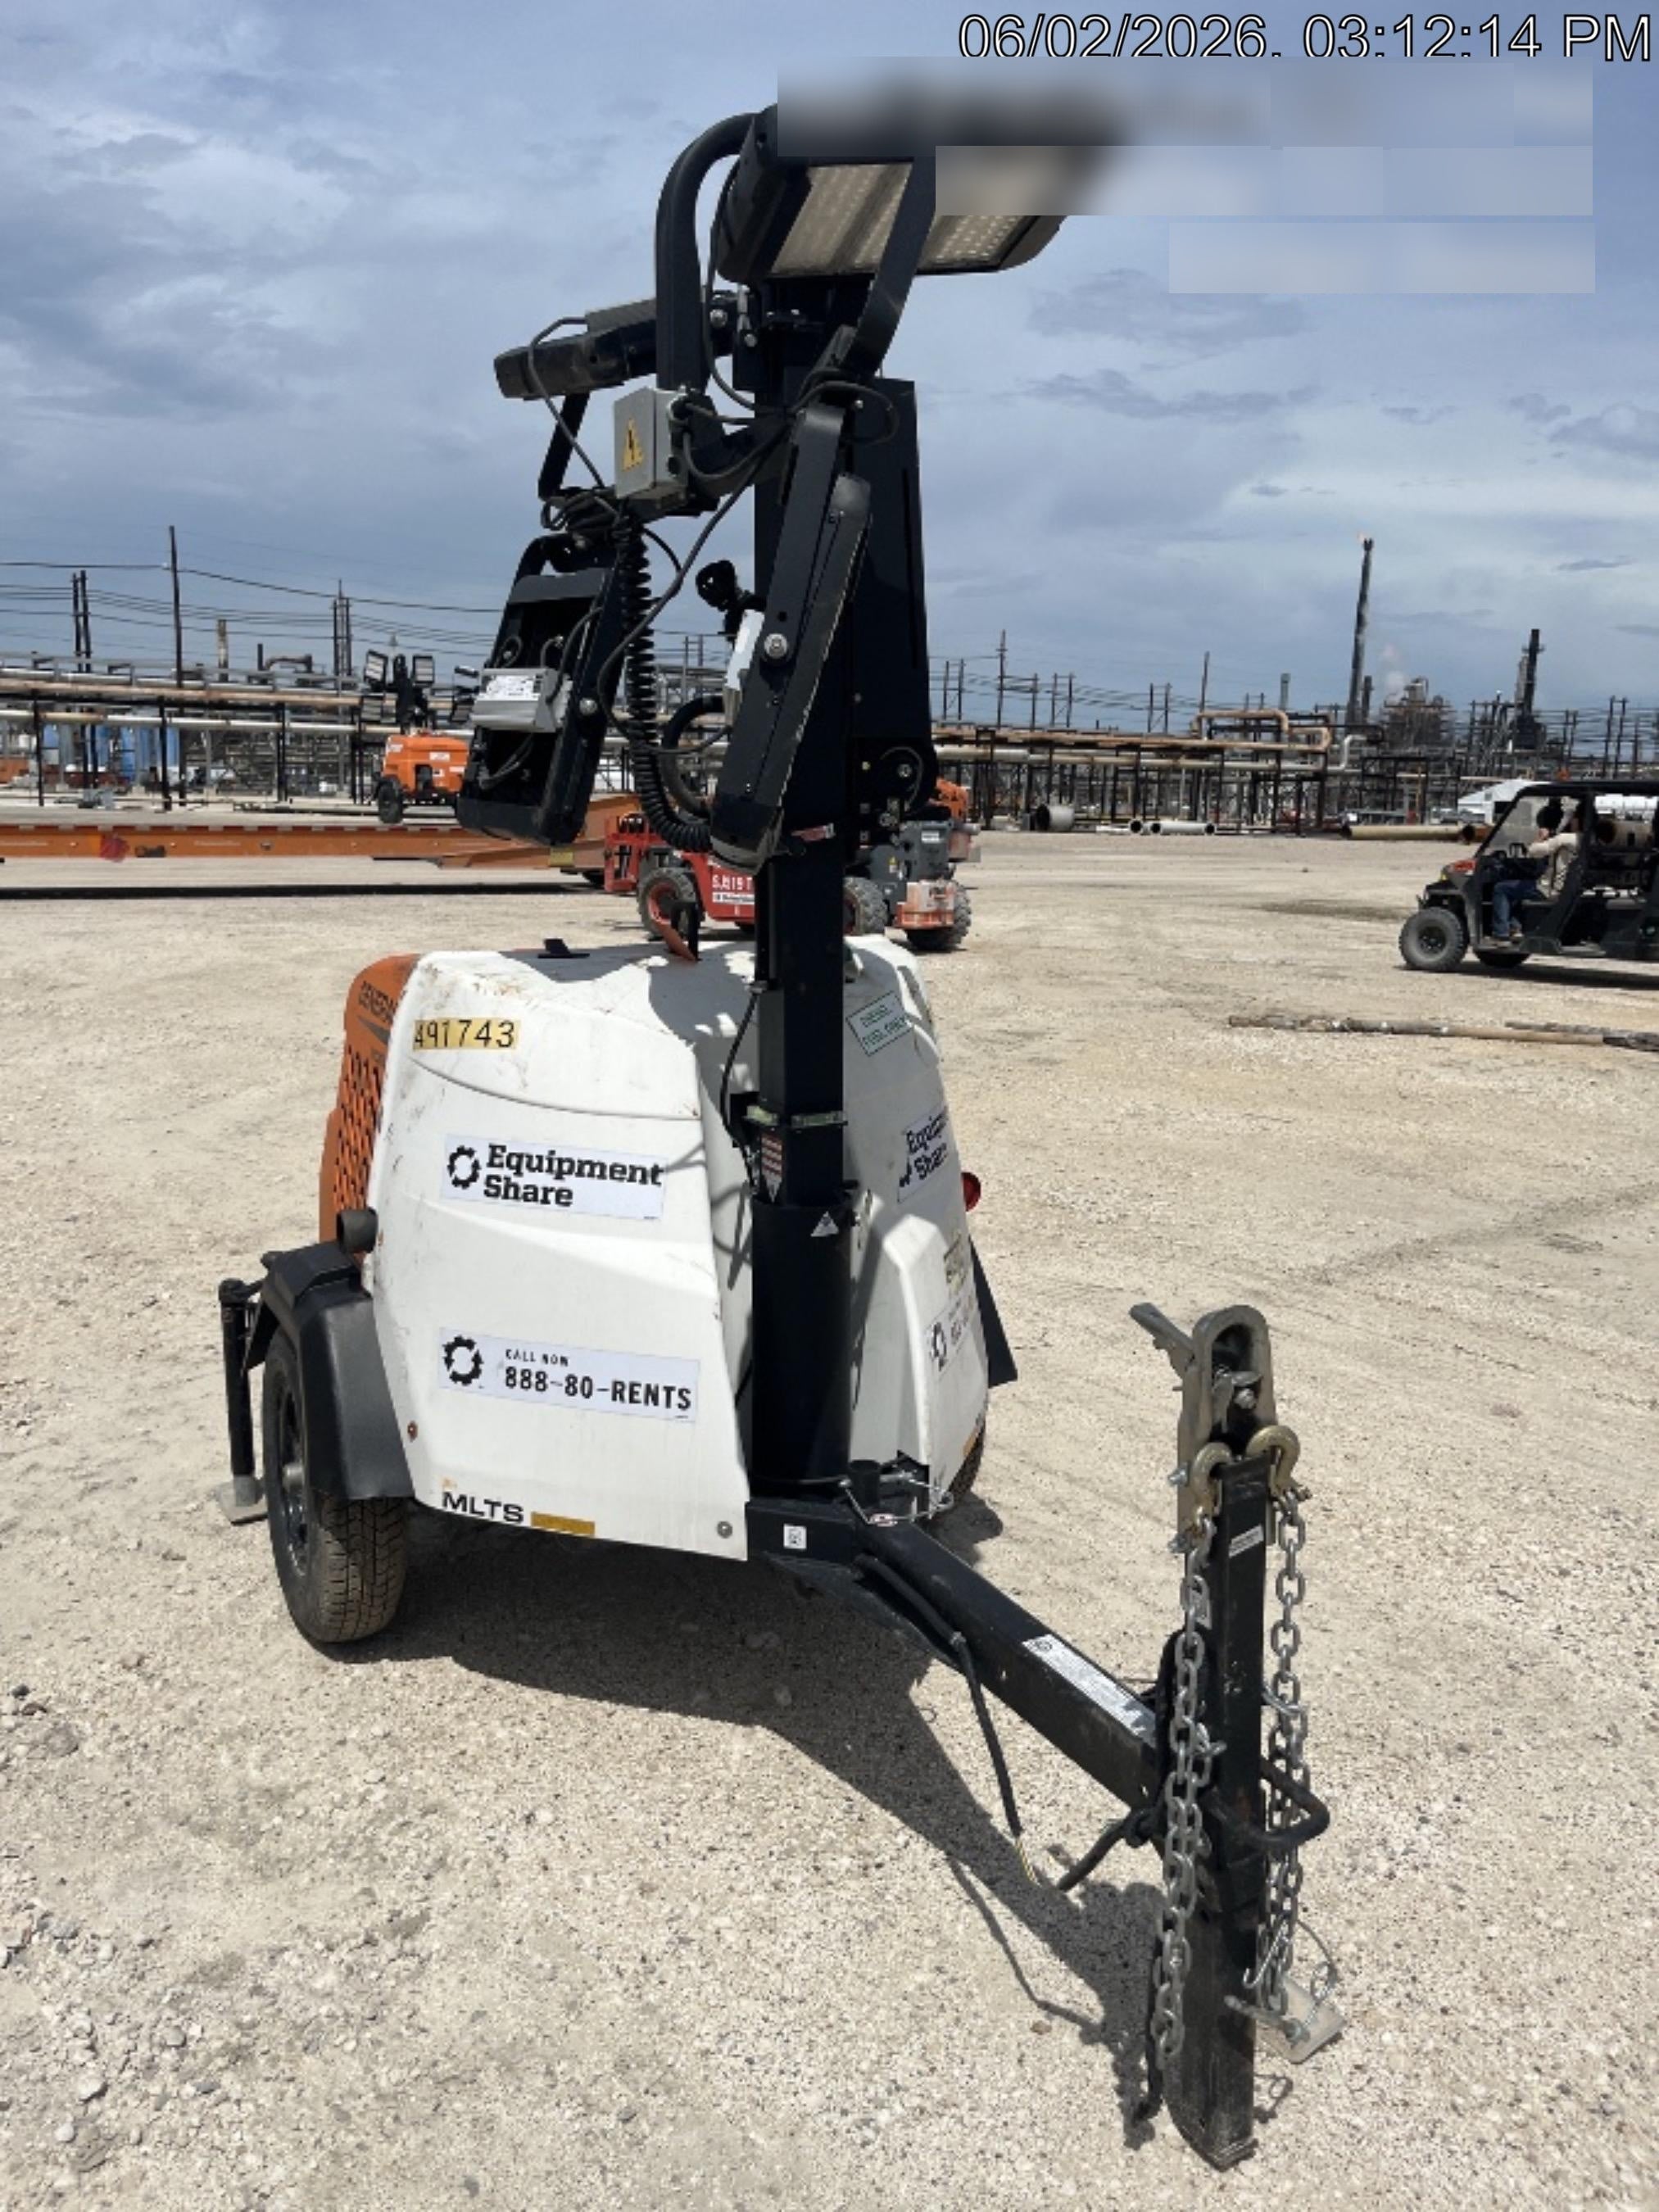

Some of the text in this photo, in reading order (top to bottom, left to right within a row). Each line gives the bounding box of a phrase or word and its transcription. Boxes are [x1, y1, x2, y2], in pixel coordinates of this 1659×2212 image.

[415, 1018, 514, 1049] 491743
[486, 1142, 664, 1187] Equipment
[483, 1173, 573, 1208] Share
[505, 1348, 569, 1367] CALL NOW
[505, 1365, 691, 1412] 888-80-RENTS
[442, 1490, 524, 1524] MLTS
